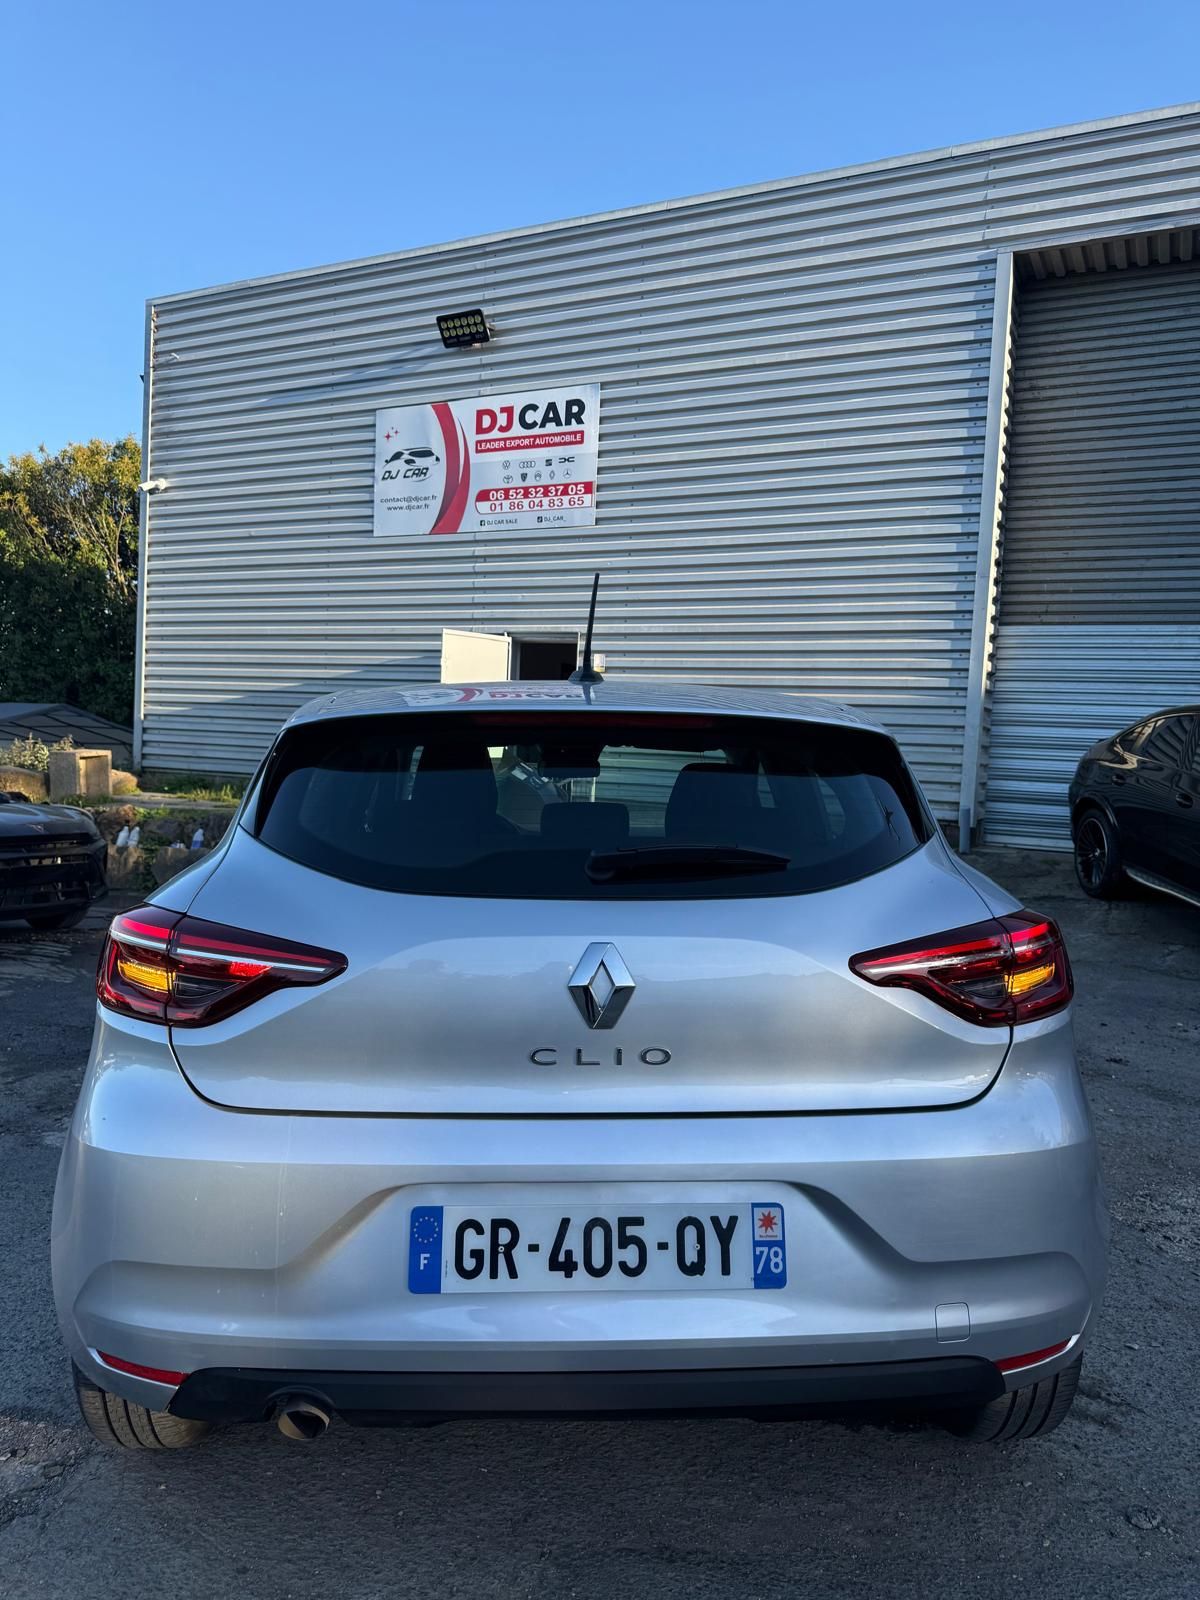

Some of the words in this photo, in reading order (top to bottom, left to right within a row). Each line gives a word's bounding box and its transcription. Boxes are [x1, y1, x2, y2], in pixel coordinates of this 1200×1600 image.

[475, 405, 515, 435] DJ
[518, 398, 586, 431] CAR
[477, 441, 505, 451] LEADER
[506, 438, 534, 447] EXPORT
[535, 433, 582, 445] AUTOMOBILE
[381, 469, 401, 481] DJ
[403, 467, 430, 479] CAR
[380, 494, 438, 504] contact@djcar.fr
[489, 490, 505, 500] 06
[508, 489, 524, 499] 52
[528, 487, 544, 498] 32
[548, 485, 564, 496] 37
[568, 484, 585, 495] 05
[387, 503, 430, 512] www.djcar.fr
[489, 502, 504, 512] 01
[508, 501, 524, 511] 86
[528, 499, 544, 509] 04
[548, 498, 564, 508] 83
[568, 496, 585, 507] 65
[529, 1047, 672, 1066] CLIO
[454, 1215, 739, 1280] GR-405-QY
[419, 1253, 431, 1271] F
[755, 1246, 784, 1274] 78
